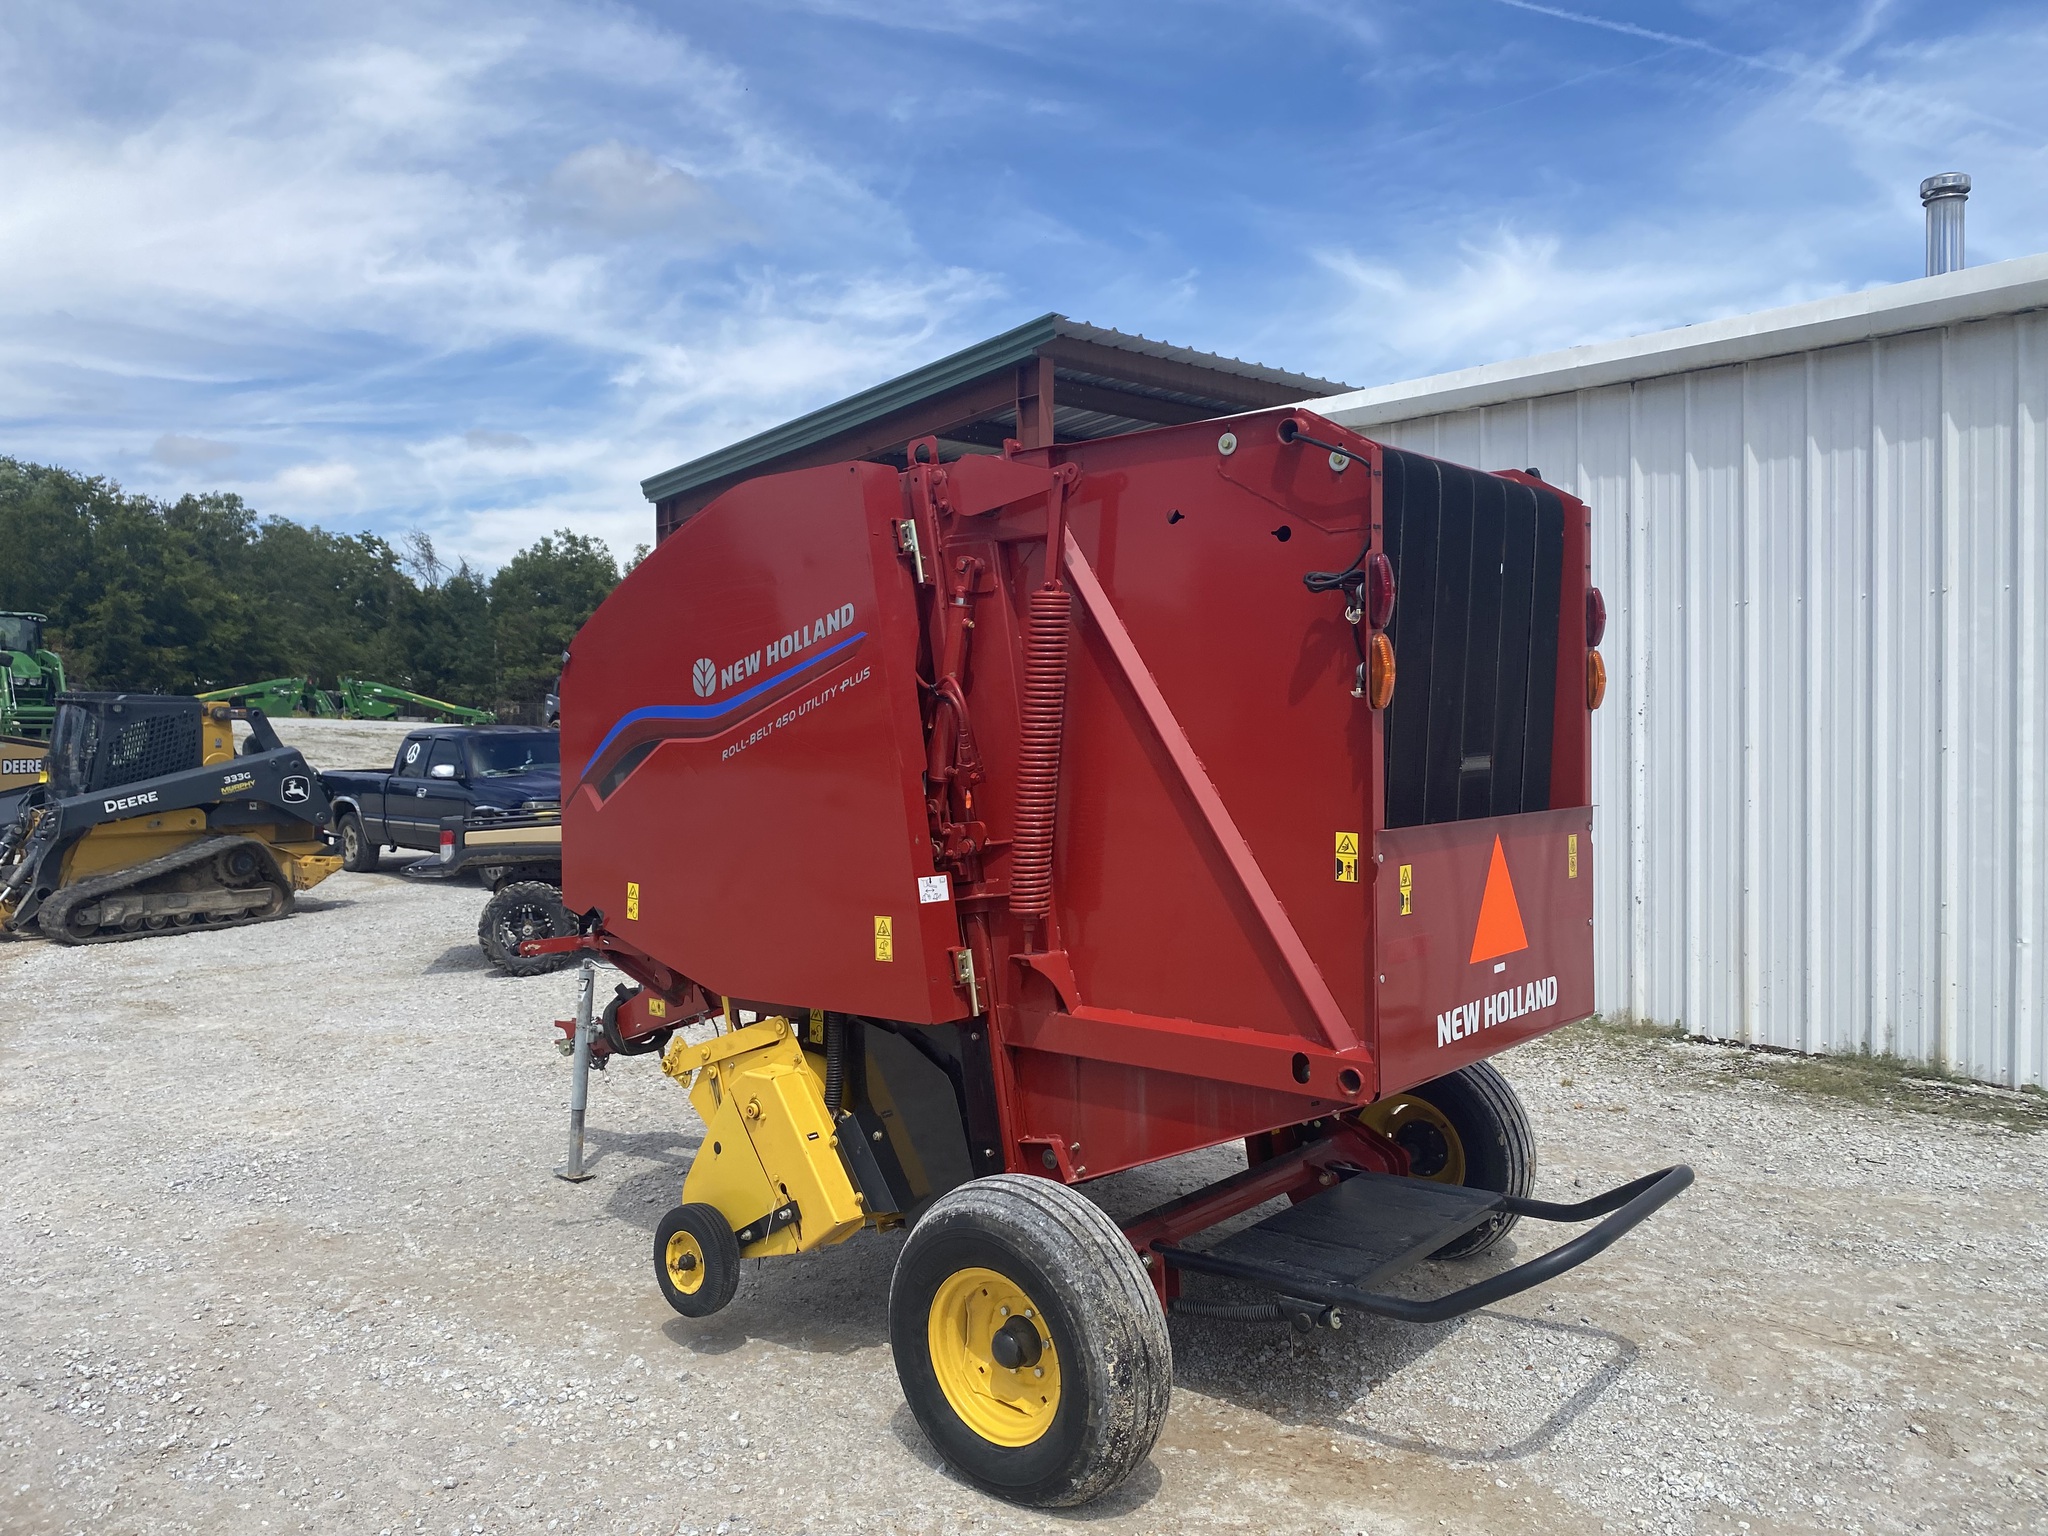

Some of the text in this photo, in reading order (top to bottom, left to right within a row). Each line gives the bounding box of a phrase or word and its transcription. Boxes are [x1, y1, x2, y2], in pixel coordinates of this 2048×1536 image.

[721, 602, 854, 690] NEW HOLLAND
[721, 722, 773, 762] ROLL-BELT
[775, 710, 796, 729] 450
[798, 685, 838, 716] UTILITY
[2, 759, 42, 774] DEERE
[223, 771, 251, 784] 333G
[220, 780, 255, 793] MURPHY
[103, 791, 159, 814] DEERE
[1437, 975, 1558, 1049] NEW HOLLAND
